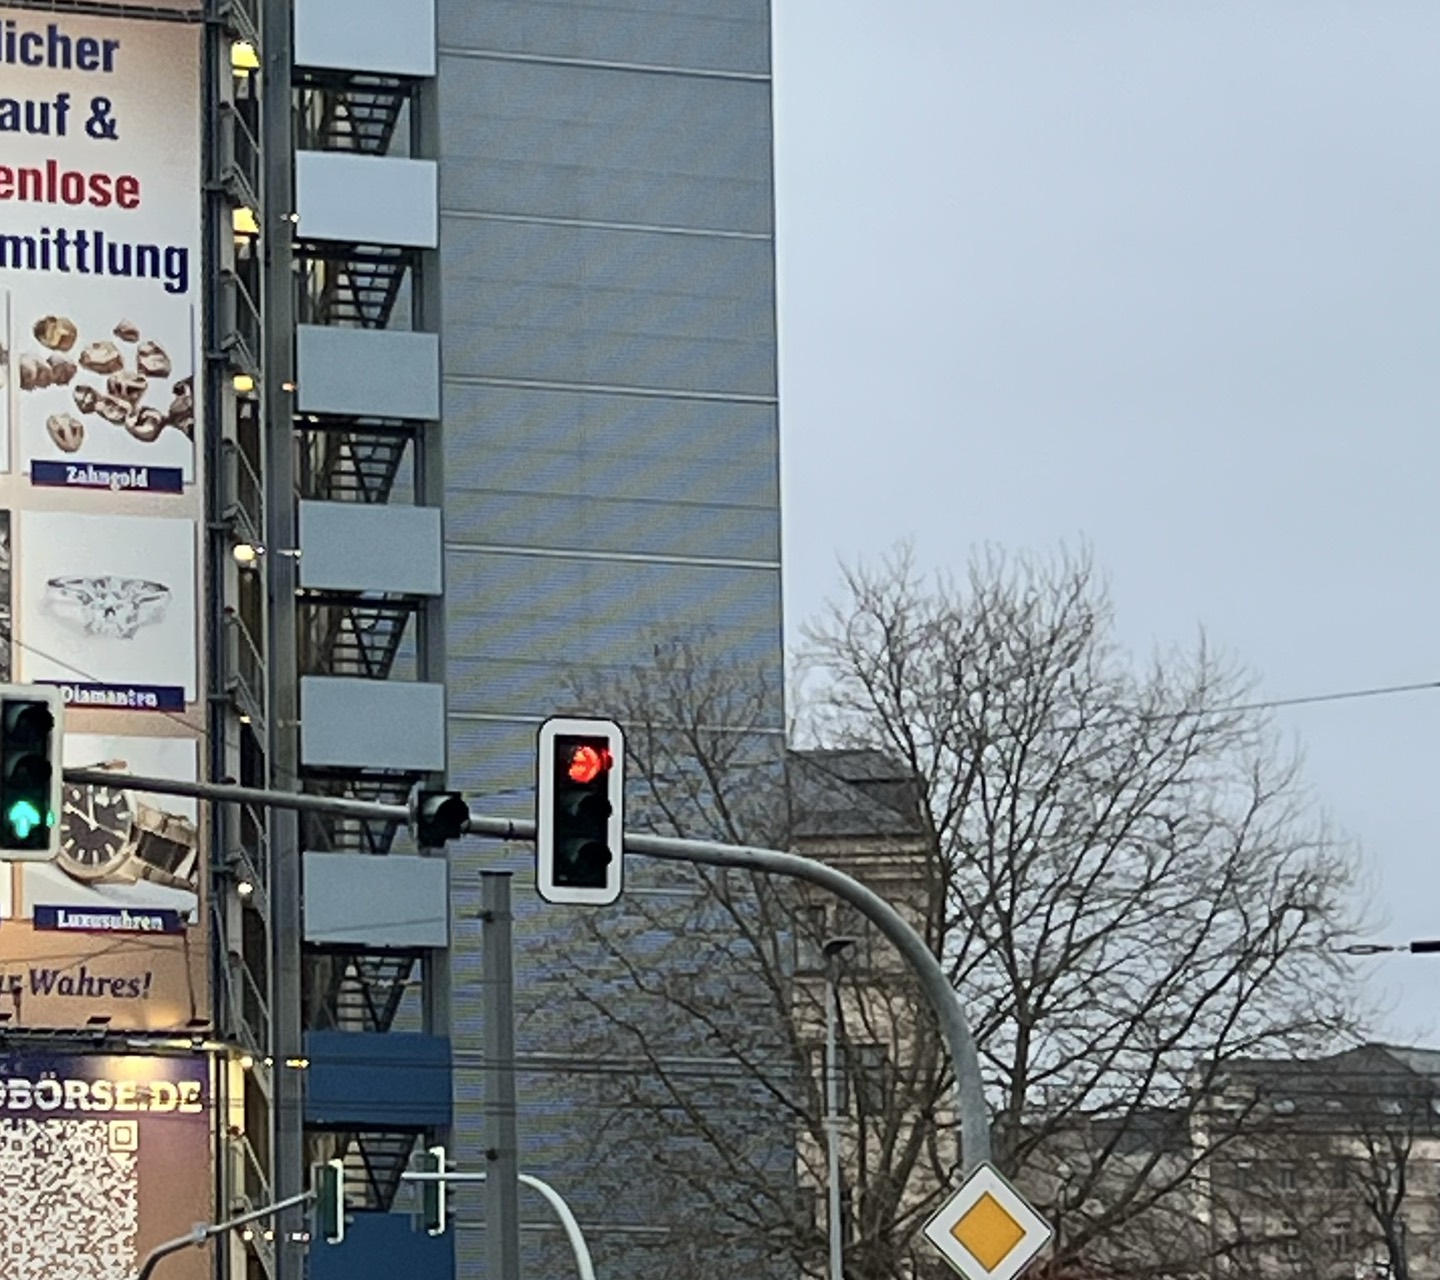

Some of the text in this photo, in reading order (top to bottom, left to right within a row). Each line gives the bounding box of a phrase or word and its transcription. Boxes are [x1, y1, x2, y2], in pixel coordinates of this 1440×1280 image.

[84, 96, 120, 140] &
[66, 465, 148, 492] Zahngold
[58, 910, 164, 931] Luxusuhren
[29, 968, 153, 1000] Wahres!
